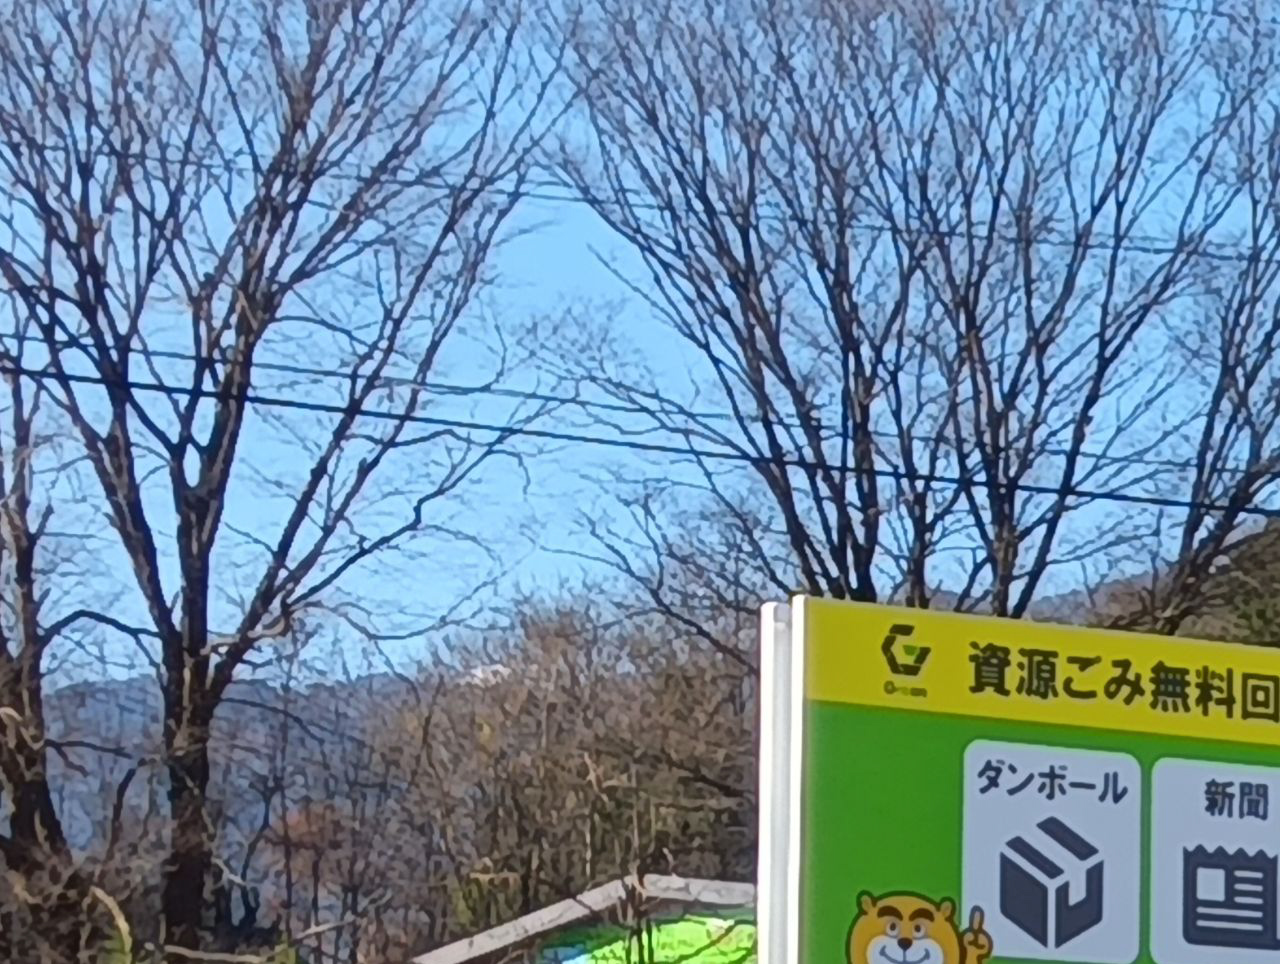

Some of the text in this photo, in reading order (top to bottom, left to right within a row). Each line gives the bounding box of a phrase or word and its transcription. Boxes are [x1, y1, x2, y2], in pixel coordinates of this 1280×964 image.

[977, 759, 1128, 804] ダンボール
[1204, 778, 1269, 820] 新聞
